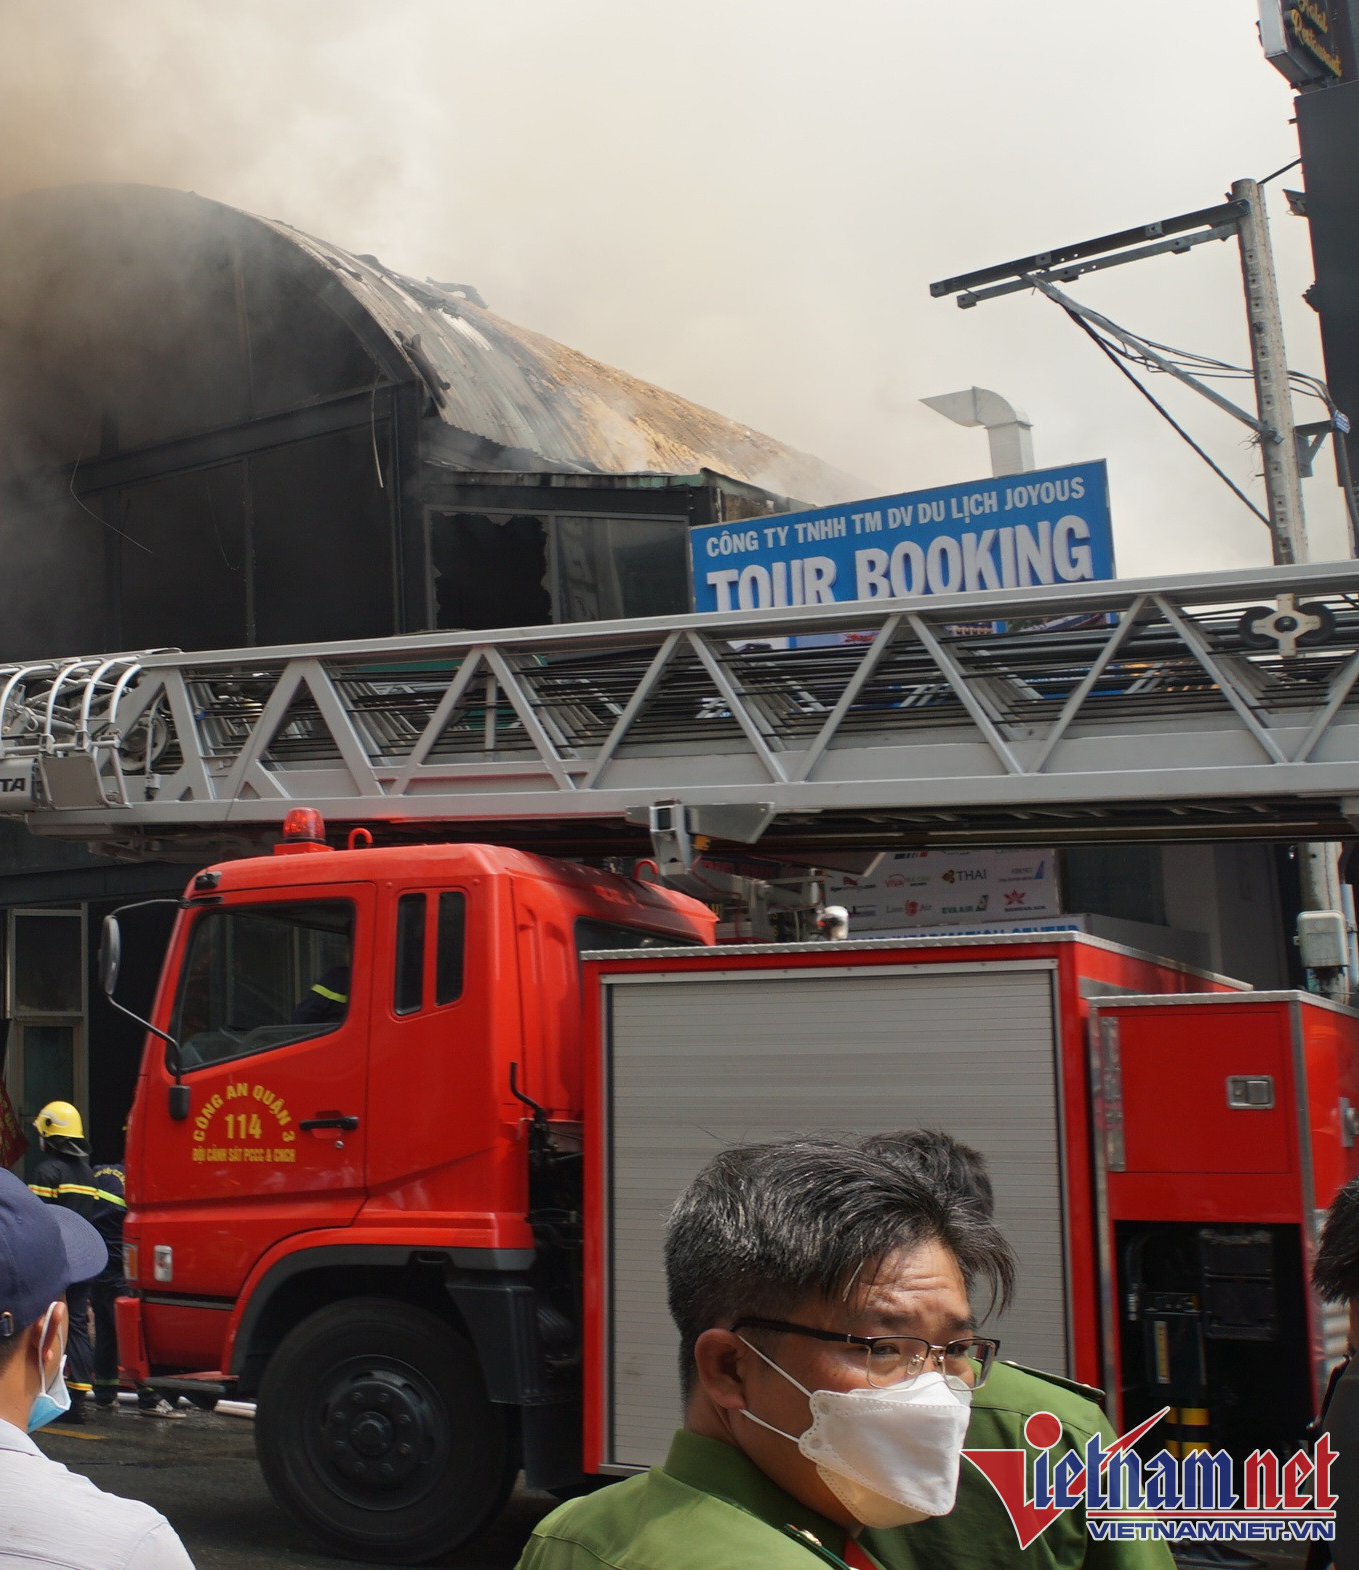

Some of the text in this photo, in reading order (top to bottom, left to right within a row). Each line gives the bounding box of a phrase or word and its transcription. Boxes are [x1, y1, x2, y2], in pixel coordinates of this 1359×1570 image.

[706, 477, 1086, 558] CÔNG TY TNHH TM DV DU LỊCH JOYOUS
[707, 515, 1094, 612] TOUR BOOKING
[957, 869, 987, 881] THAI
[193, 1082, 296, 1143] CÔNG AN QUẬN 3
[225, 1113, 263, 1139] 114
